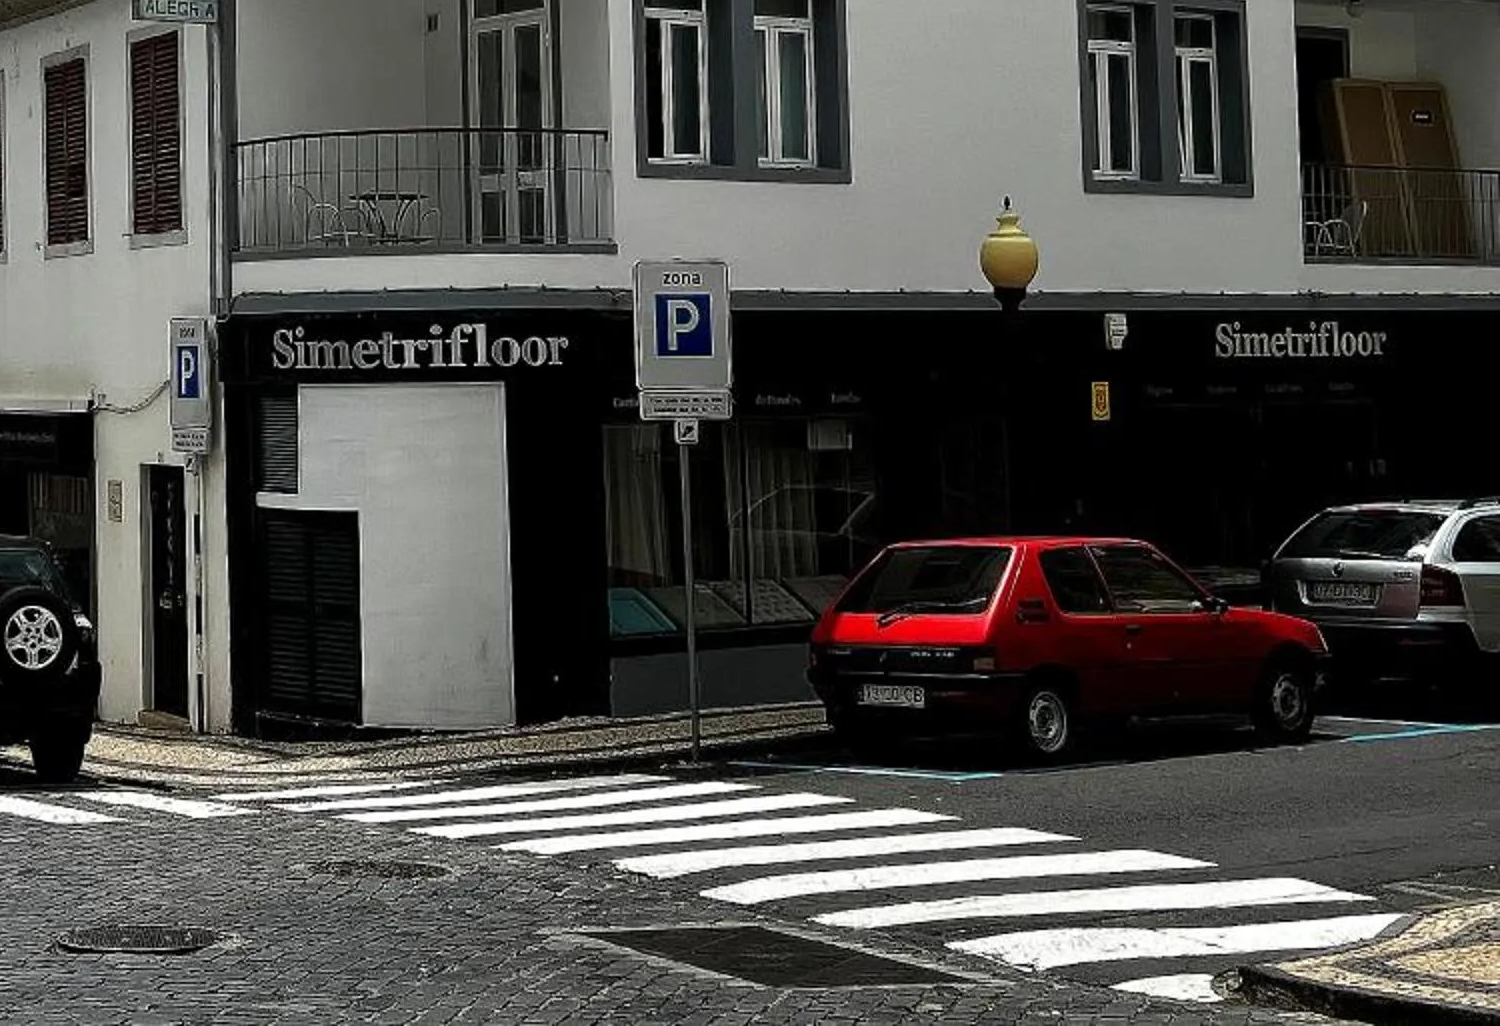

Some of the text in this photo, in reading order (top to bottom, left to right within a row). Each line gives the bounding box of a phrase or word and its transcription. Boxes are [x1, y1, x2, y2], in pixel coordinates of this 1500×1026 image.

[663, 273, 701, 285] zona
[272, 324, 569, 369] Simetrifloor
[667, 299, 700, 351] P
[1215, 321, 1387, 357] Simetrifloor
[181, 349, 194, 394] P
